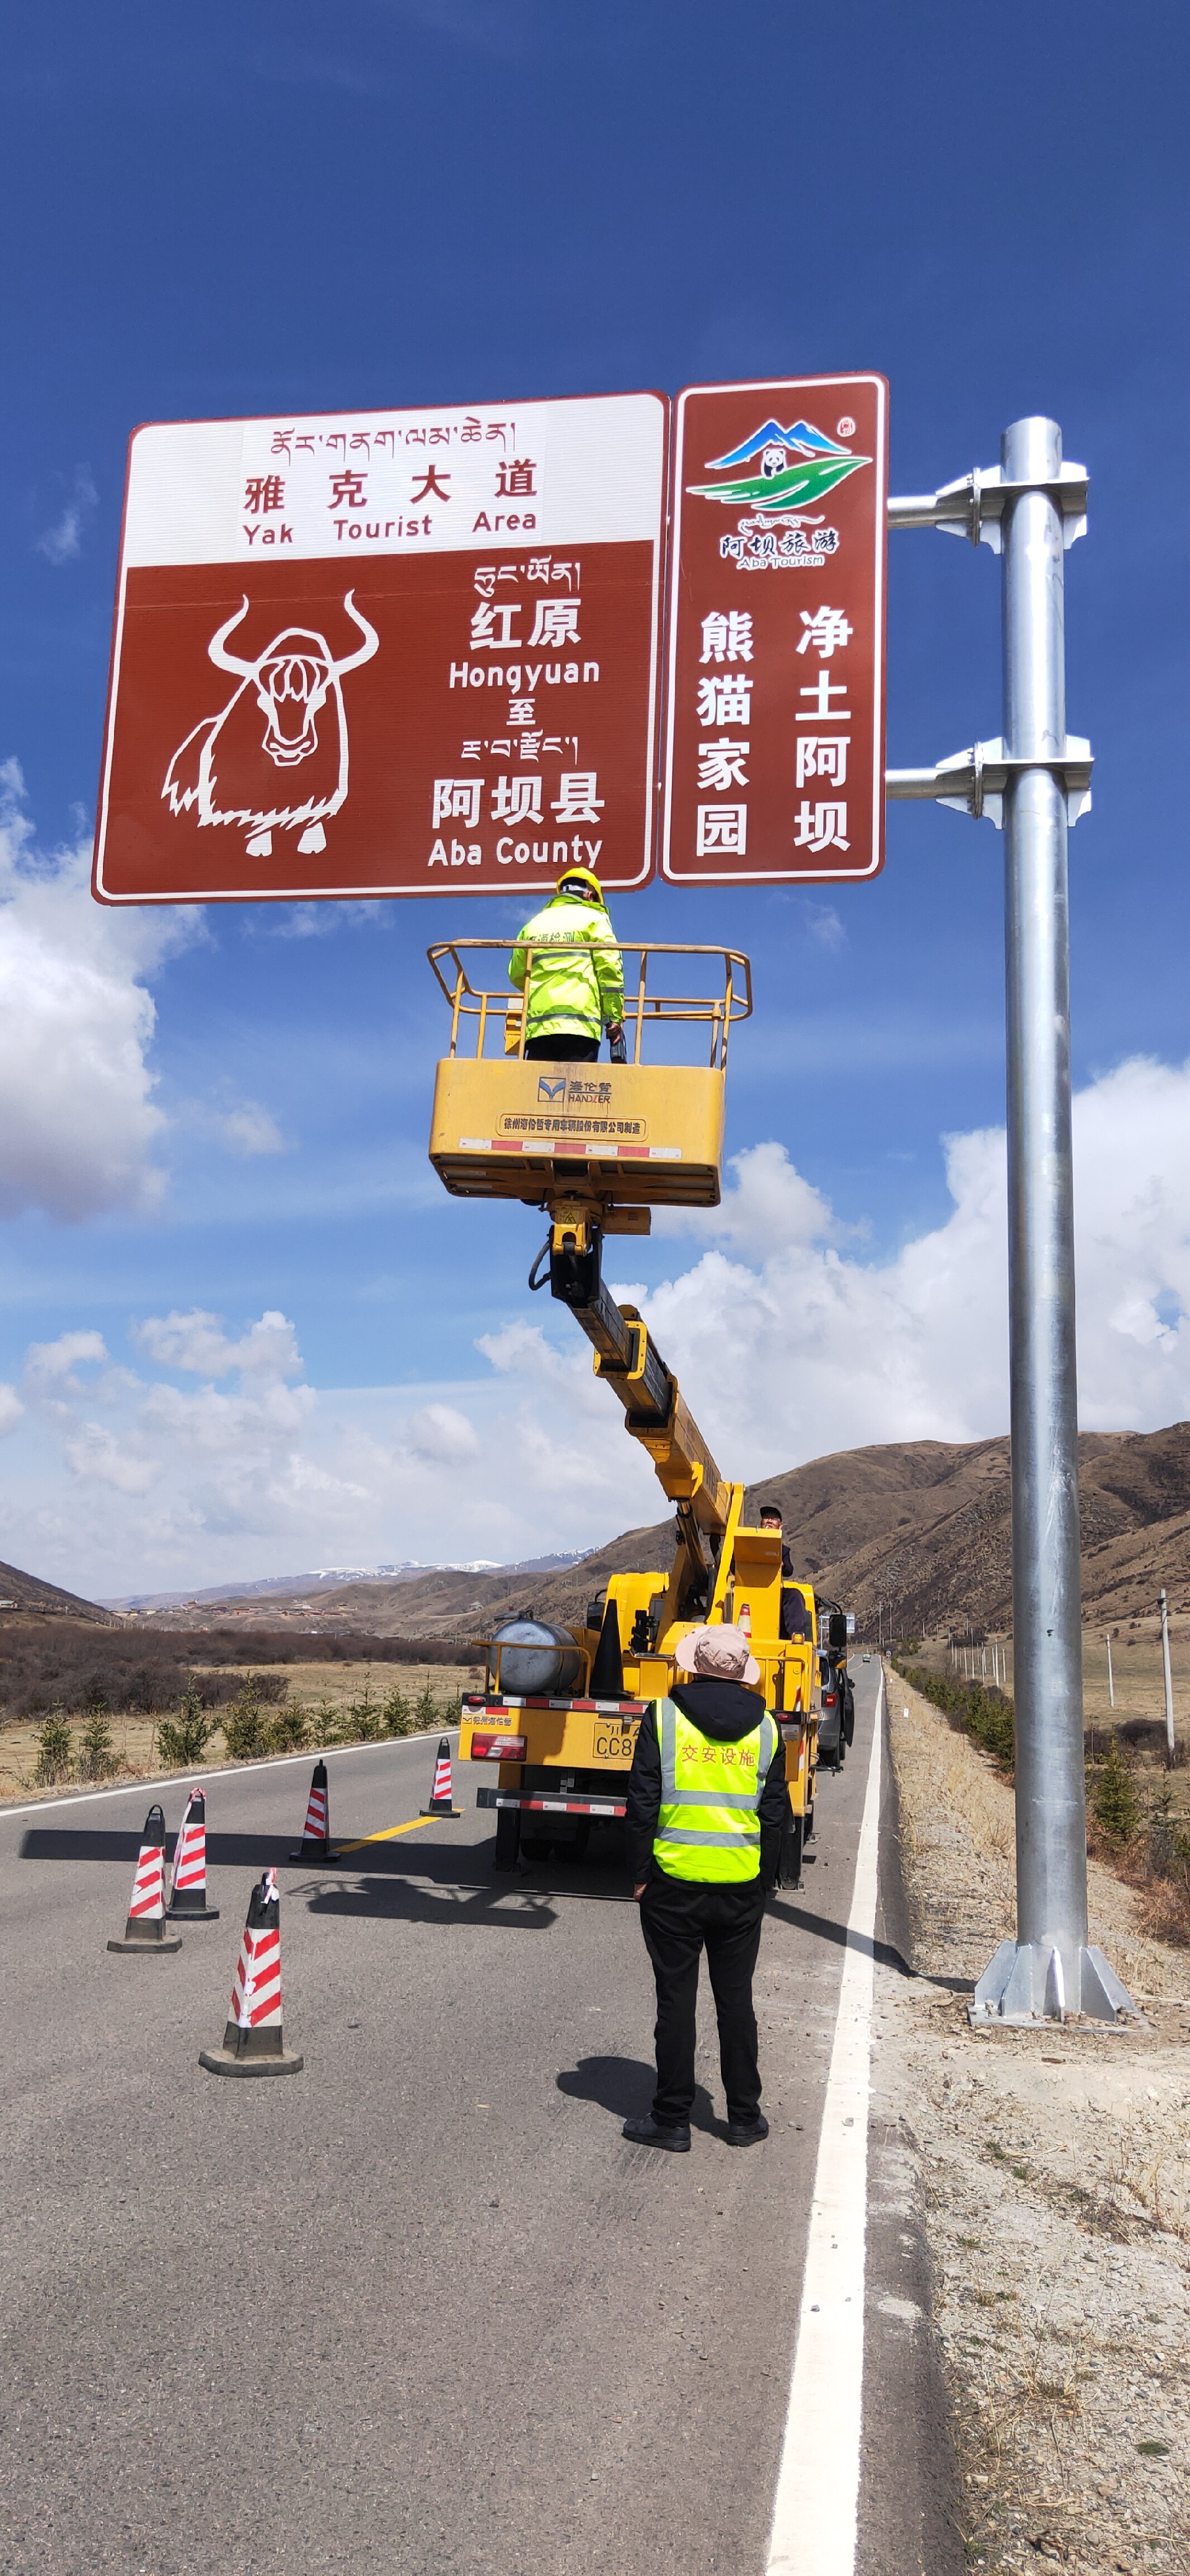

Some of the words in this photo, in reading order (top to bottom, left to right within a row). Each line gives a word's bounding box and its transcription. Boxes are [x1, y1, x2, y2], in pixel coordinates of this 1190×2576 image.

[244, 459, 537, 514] 雅克大道
[244, 523, 294, 545] Yak
[333, 515, 432, 540] Tourist
[472, 511, 537, 533] Area
[722, 530, 837, 556] 阿坝旅游
[738, 558, 766, 568] Aba
[770, 556, 823, 568] Tourism
[469, 599, 581, 650] 红原
[449, 662, 599, 695] Hongyuan
[506, 698, 536, 725] 至
[696, 610, 754, 856] 熊猫家园
[793, 605, 853, 853] 净土阿坝
[432, 772, 604, 829] 阿坝县
[428, 839, 482, 867] Aba
[496, 834, 602, 868] County
[682, 1744, 755, 1767] 交安设施
